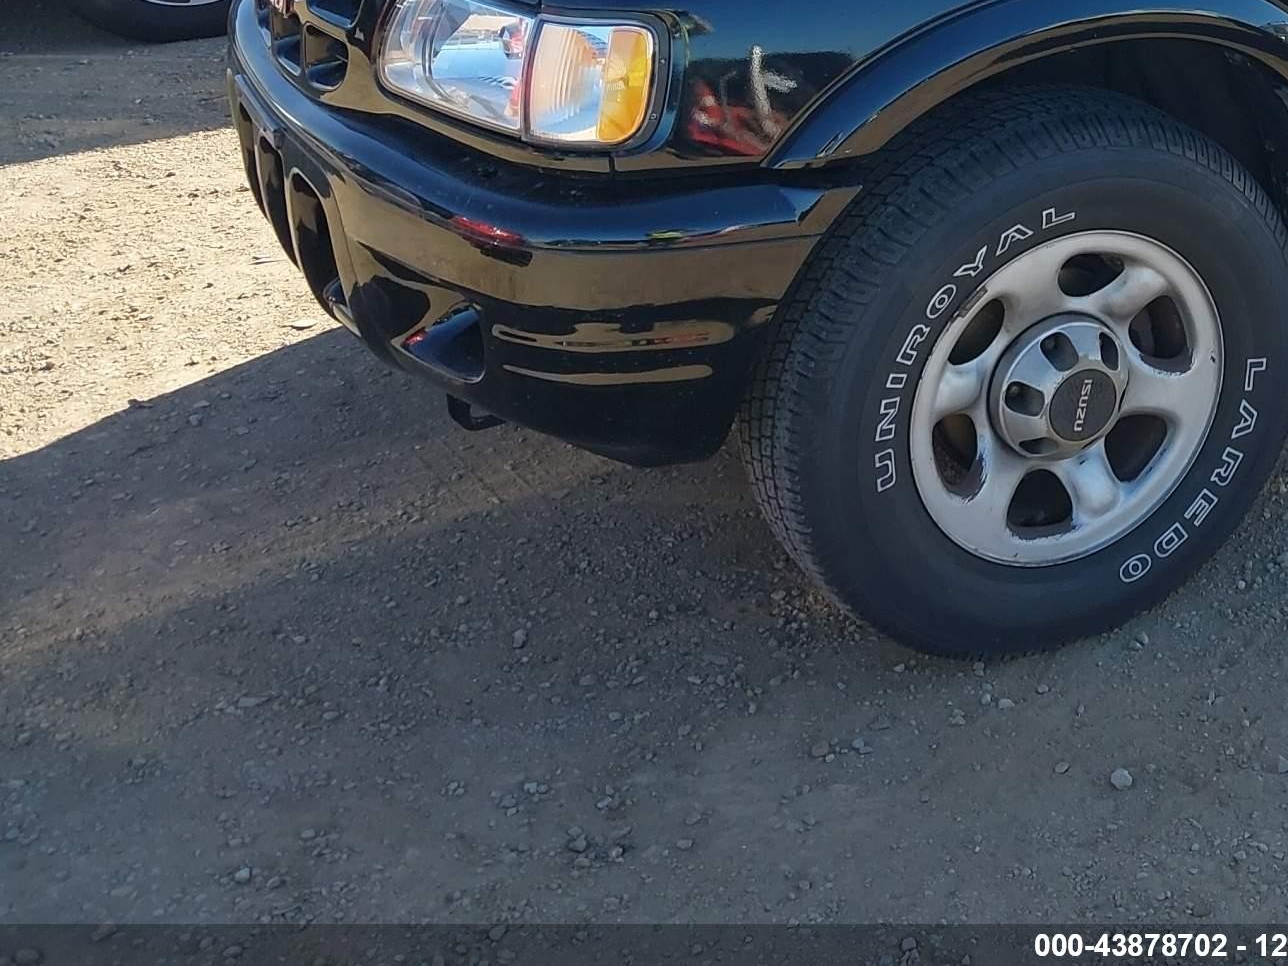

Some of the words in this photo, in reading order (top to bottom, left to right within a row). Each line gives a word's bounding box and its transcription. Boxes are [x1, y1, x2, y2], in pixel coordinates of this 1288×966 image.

[875, 207, 1076, 493] UNIROYAL
[1073, 378, 1093, 432] ISUZU
[1119, 357, 1267, 583] LAREDO
